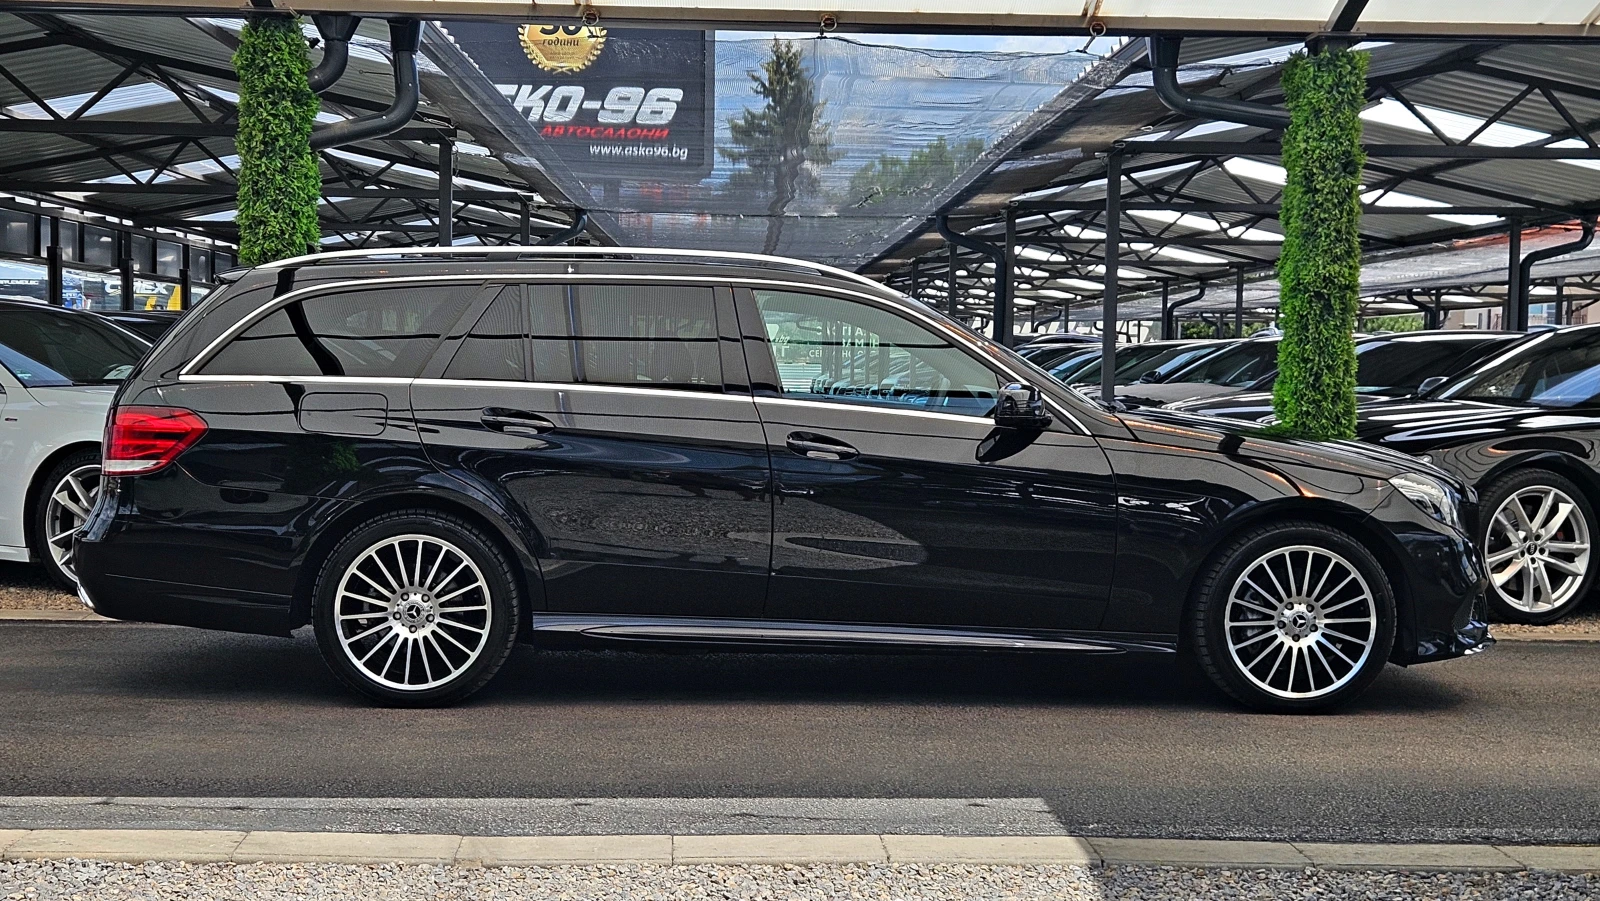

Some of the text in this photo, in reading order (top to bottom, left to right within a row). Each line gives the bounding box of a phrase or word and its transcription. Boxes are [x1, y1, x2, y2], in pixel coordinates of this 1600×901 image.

[542, 37, 580, 47] години
[540, 125, 669, 140] АВТОСАЛОНИ
[589, 143, 688, 160] www.asko96.bg
